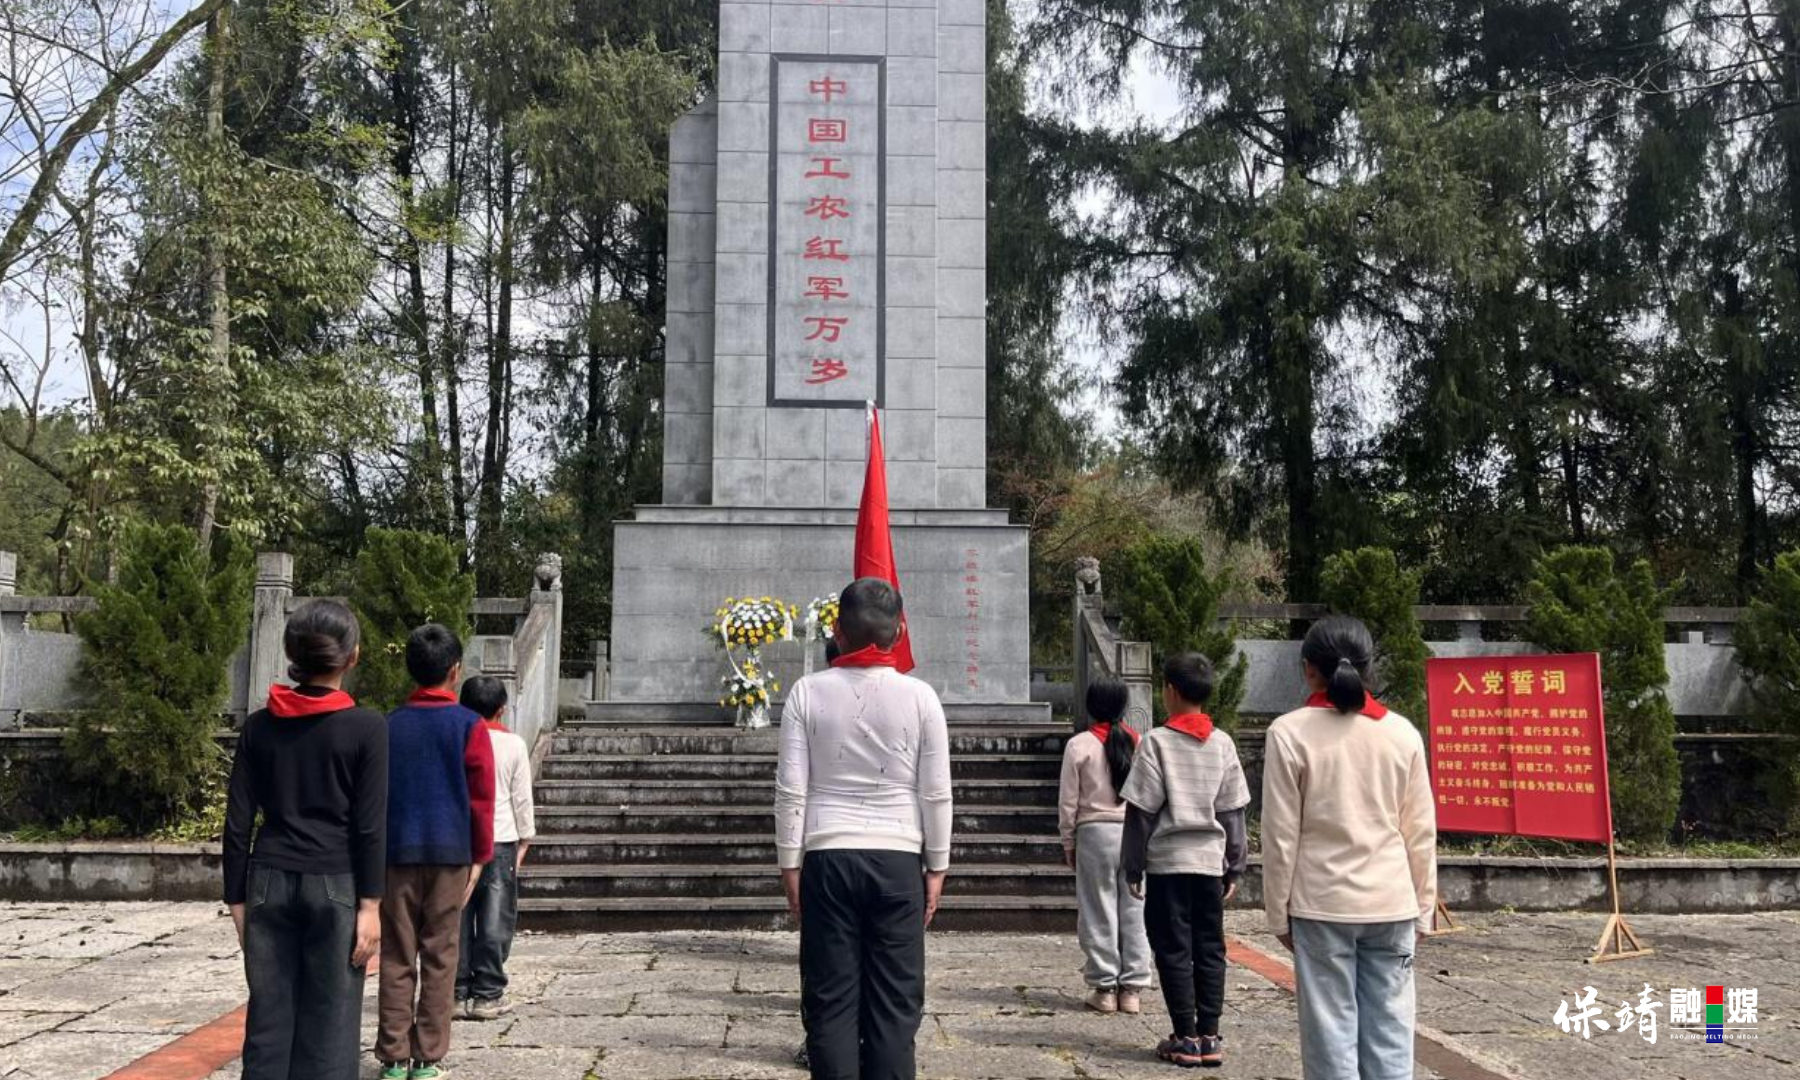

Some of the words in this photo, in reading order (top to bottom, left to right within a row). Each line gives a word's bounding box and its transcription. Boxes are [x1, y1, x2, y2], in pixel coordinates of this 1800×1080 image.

[802, 75, 850, 385] 中国工农红军万岁
[1453, 669, 1567, 695] 入党誓词
